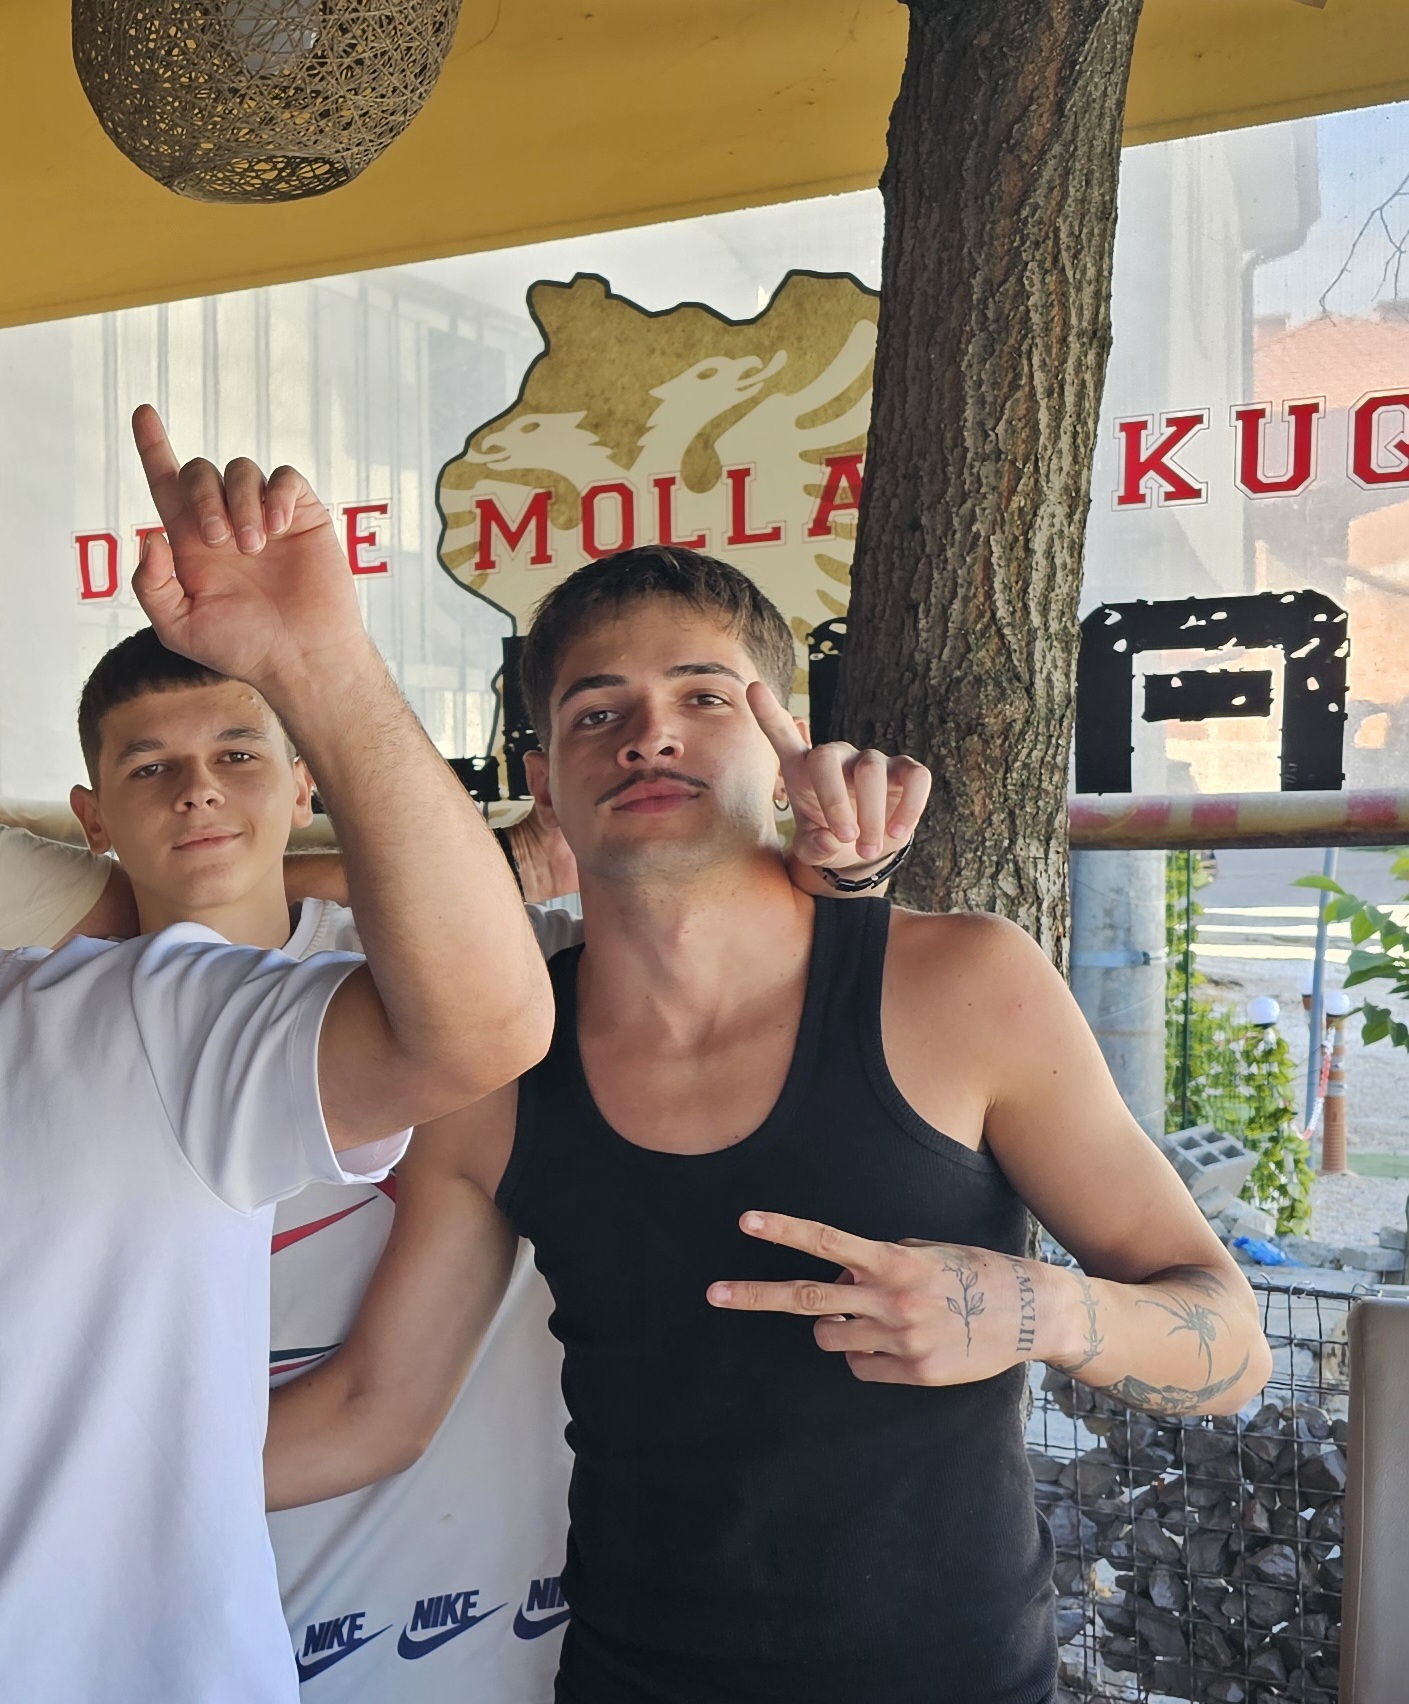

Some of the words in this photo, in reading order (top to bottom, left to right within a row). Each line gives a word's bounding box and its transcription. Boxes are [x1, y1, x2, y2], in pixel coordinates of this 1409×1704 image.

[474, 453, 863, 571] MOLLA
[301, 1611, 366, 1657] NIKE
[410, 1589, 480, 1632] NIKE
